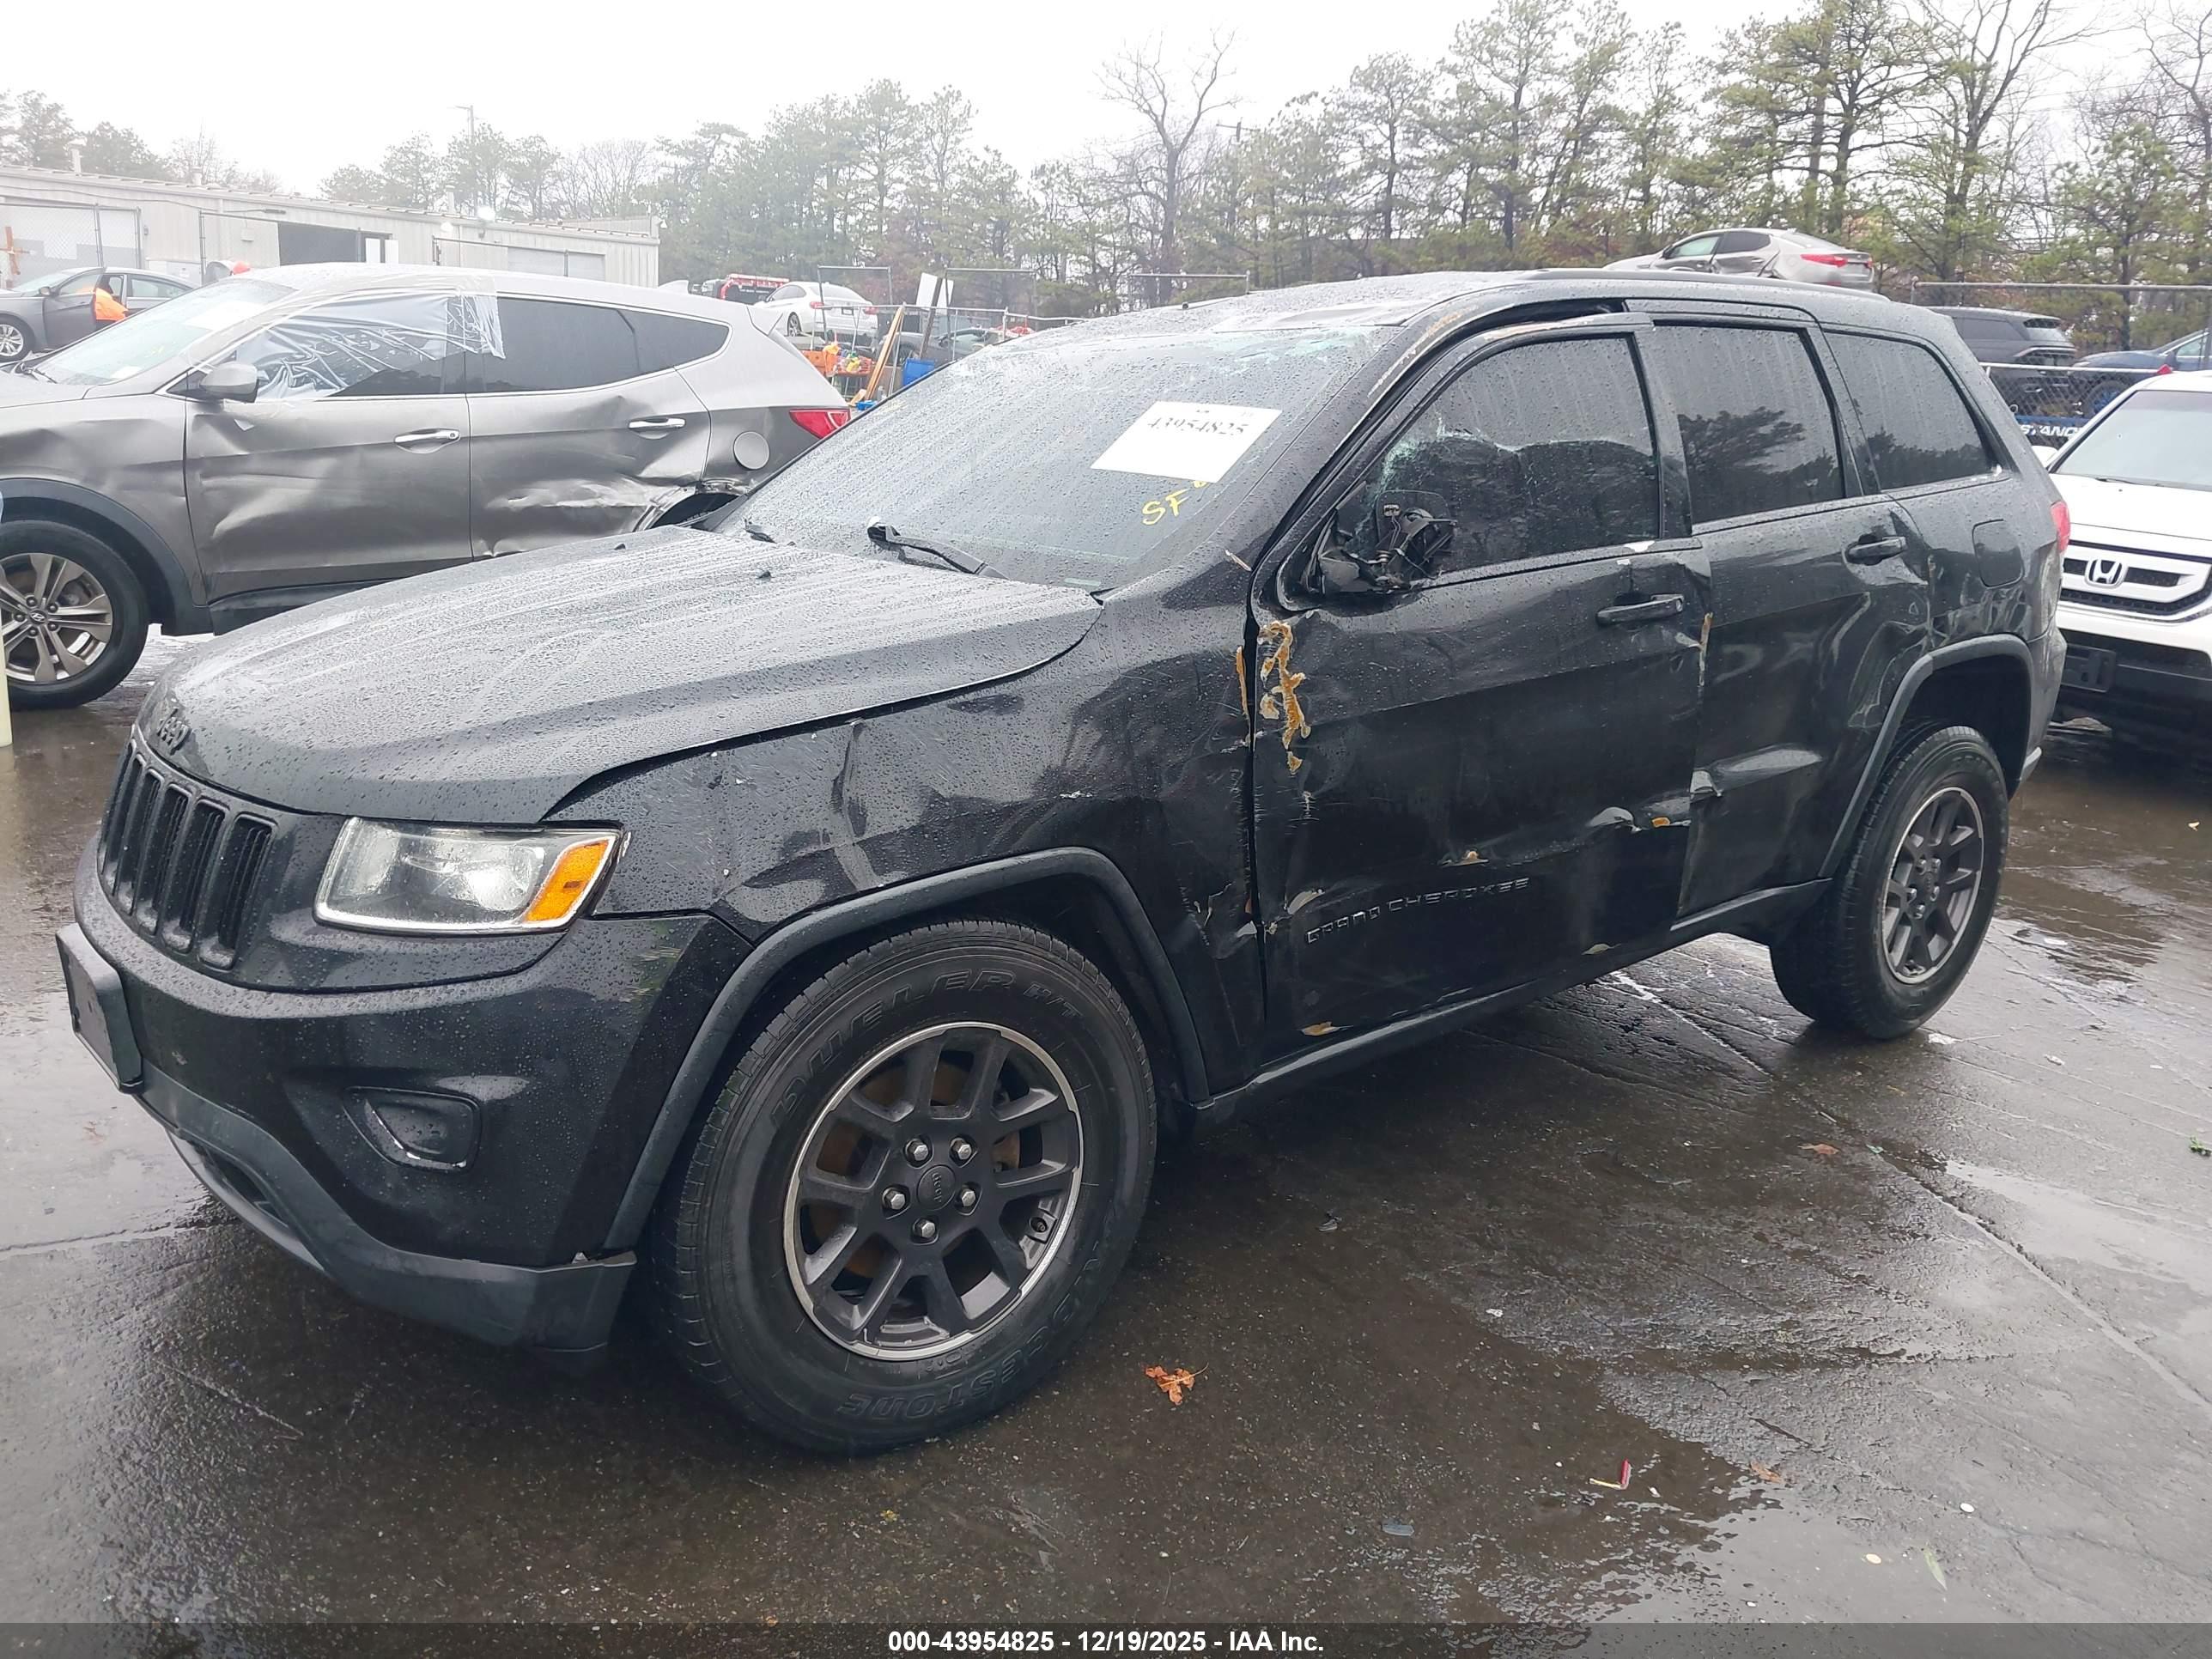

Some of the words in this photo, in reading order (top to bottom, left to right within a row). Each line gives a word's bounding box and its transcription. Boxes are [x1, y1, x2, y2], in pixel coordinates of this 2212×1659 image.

[1142, 481, 1206, 526] SF
[1307, 905, 1382, 944] GRAND
[1389, 878, 1530, 912] CHEROKEE
